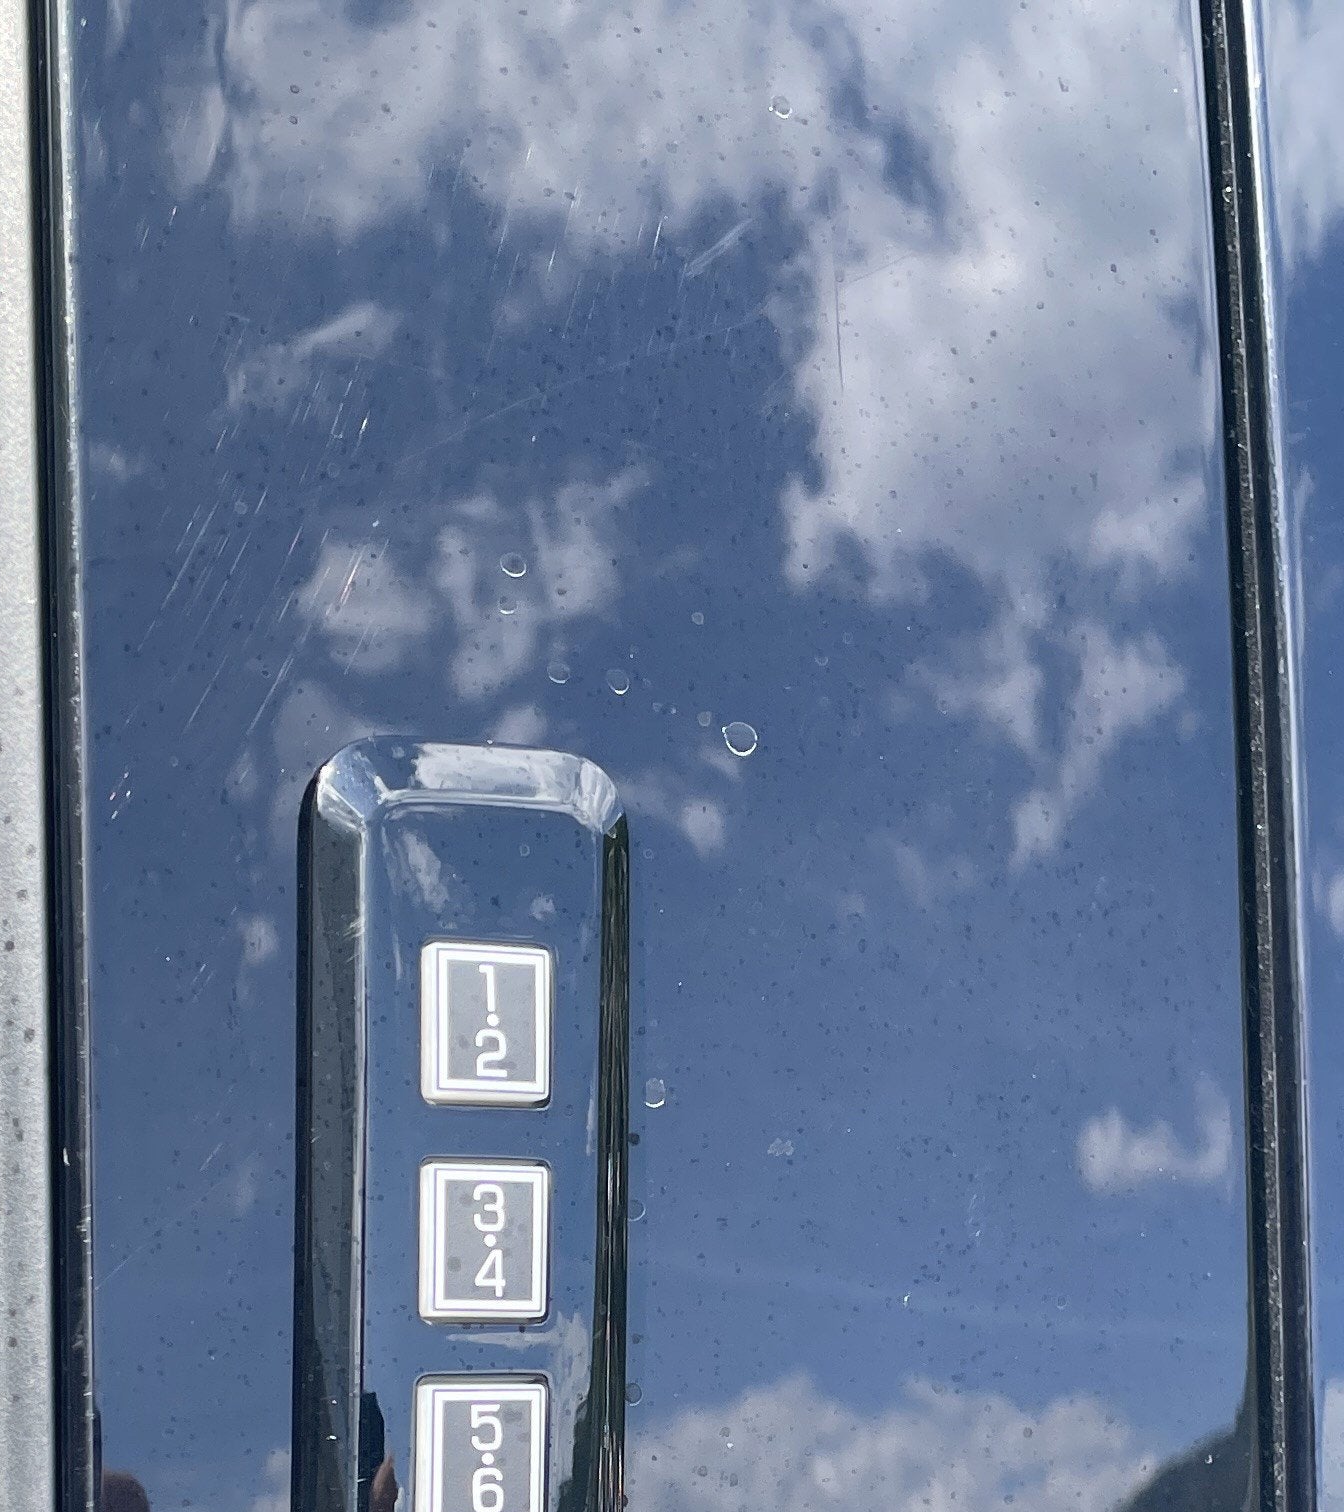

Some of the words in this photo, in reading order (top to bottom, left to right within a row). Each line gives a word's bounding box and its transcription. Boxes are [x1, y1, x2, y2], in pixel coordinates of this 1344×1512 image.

[477, 964, 497, 1013] 1
[475, 1028, 508, 1078] 2
[472, 1183, 506, 1232] 3
[474, 1248, 506, 1298] 4
[470, 1403, 503, 1452] 5
